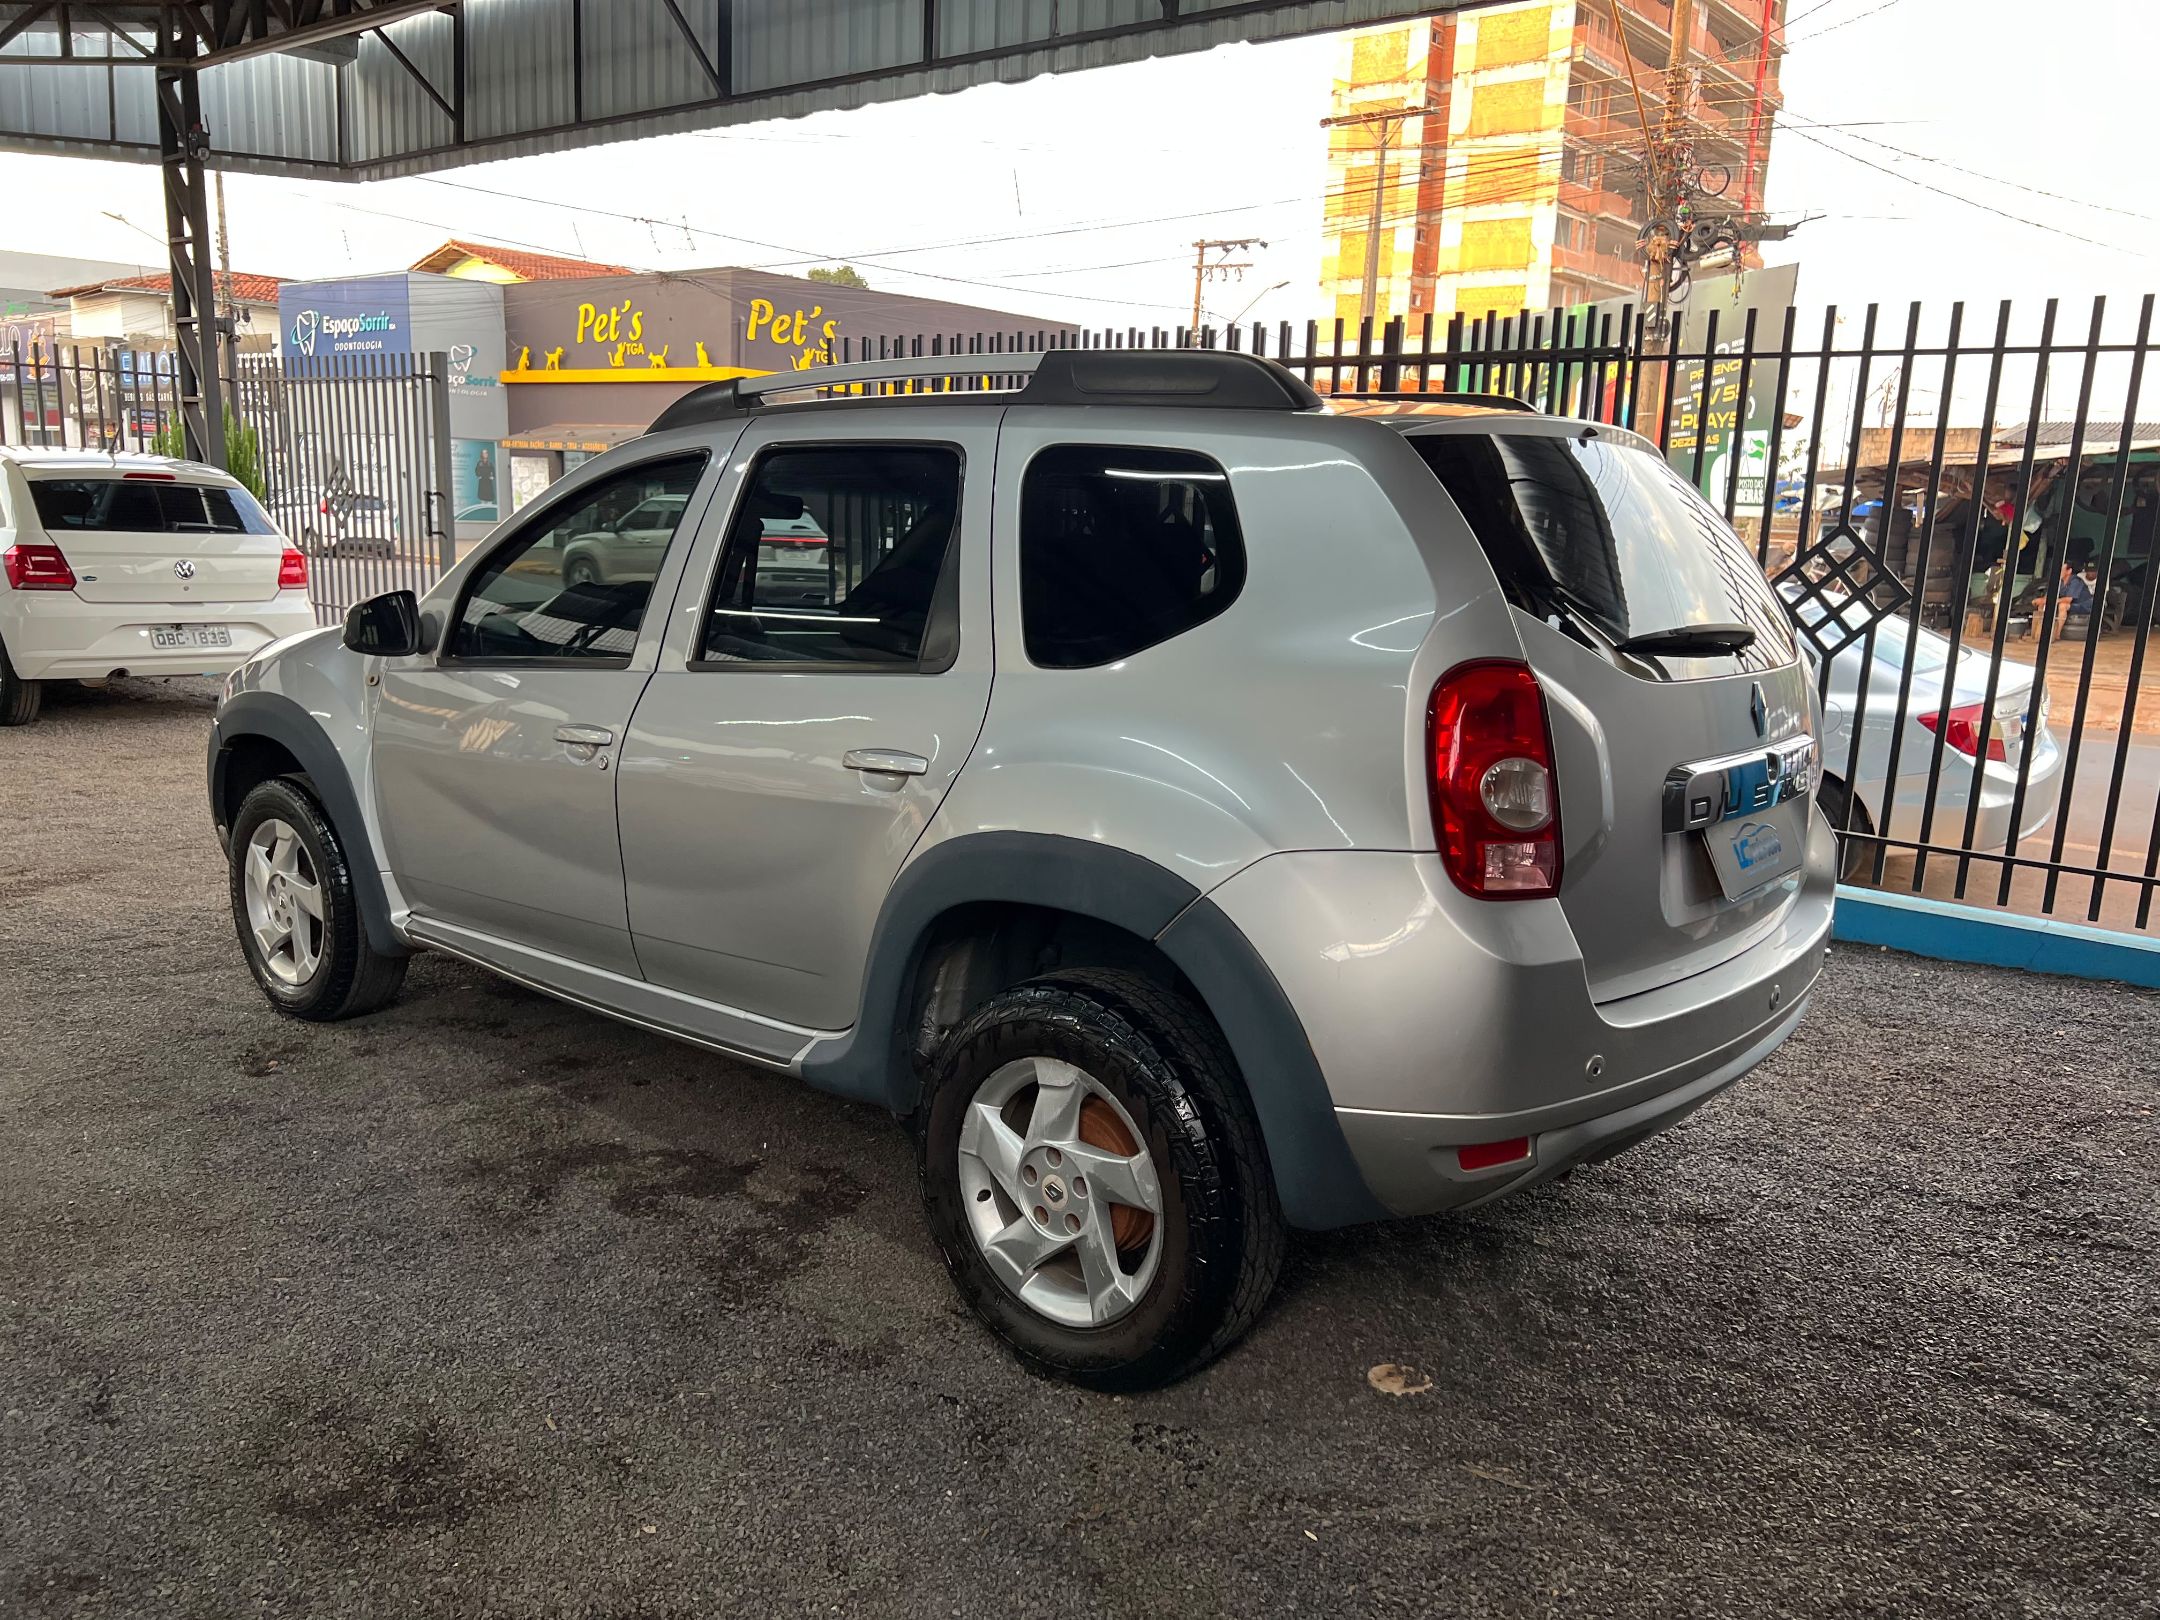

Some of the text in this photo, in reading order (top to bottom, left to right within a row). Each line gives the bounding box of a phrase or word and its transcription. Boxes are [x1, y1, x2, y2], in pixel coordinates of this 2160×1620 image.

[577, 300, 642, 344] Pet's
[747, 299, 836, 346] Pet's
[334, 340, 382, 352] ODONTOLOGIA
[626, 344, 645, 356] TGA
[1670, 434, 1720, 449] DEZEAS
[1738, 479, 1754, 489] POSTO
